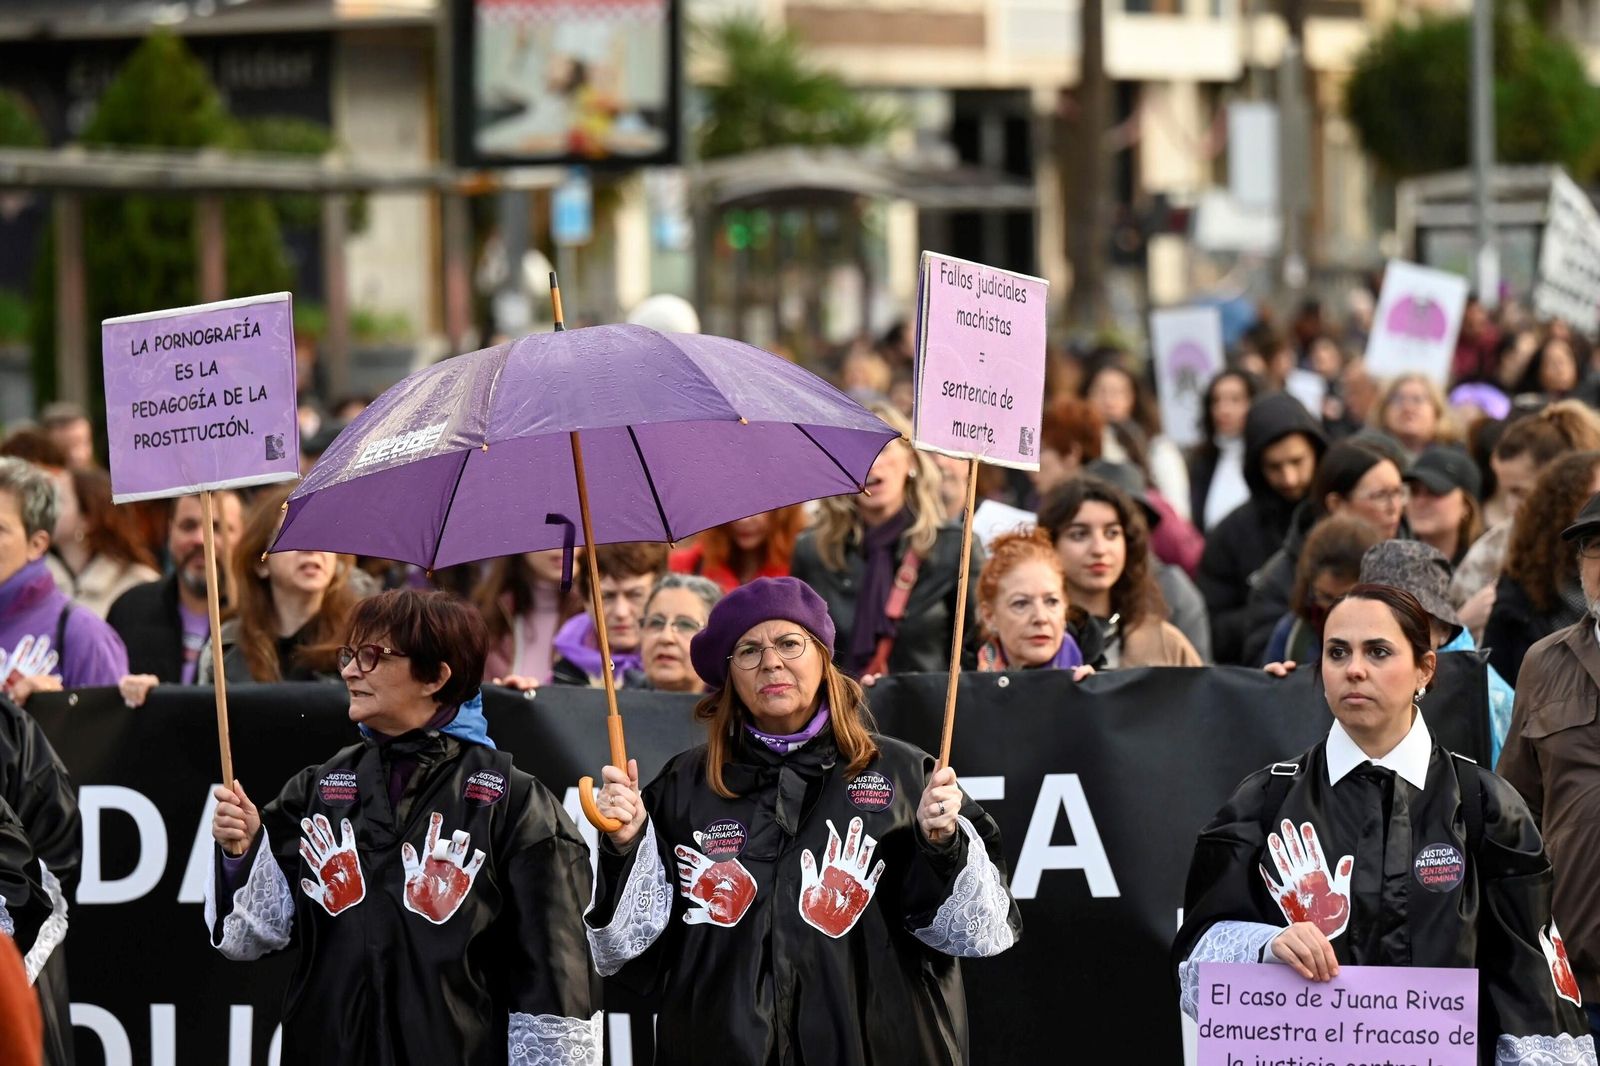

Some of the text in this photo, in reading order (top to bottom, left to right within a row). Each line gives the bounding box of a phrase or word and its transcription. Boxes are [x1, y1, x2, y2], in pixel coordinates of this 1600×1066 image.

[940, 262, 1026, 304] Fallos judiciales
[956, 308, 1012, 336] machistas
[131, 317, 261, 356] LA PORNOGRAFÍA
[175, 360, 218, 381] ES LA
[132, 385, 267, 418] PEDAGOGÍA DE LA
[942, 380, 1014, 410] sentencia de
[134, 415, 254, 450] PROSTITUCIÓN.
[952, 420, 996, 444] muerte.
[320, 779, 357, 787] PATRIARCA
[848, 782, 891, 791] PATRIARCAL
[702, 830, 744, 840] PATRIARCAL
[709, 823, 739, 832] JUSTICIA
[705, 837, 742, 849] SENTENCIA
[708, 845, 739, 855] CRIMINAL
[1421, 848, 1453, 858] JUSTICIA
[1416, 856, 1461, 867] PATRIARCAL
[1419, 864, 1460, 876] SENTENCIA
[1424, 873, 1458, 884] CRIMINAL
[1211, 983, 1465, 1011] El caso de Juana Rivas
[1200, 1018, 1475, 1046] demuestra el fracaso de
